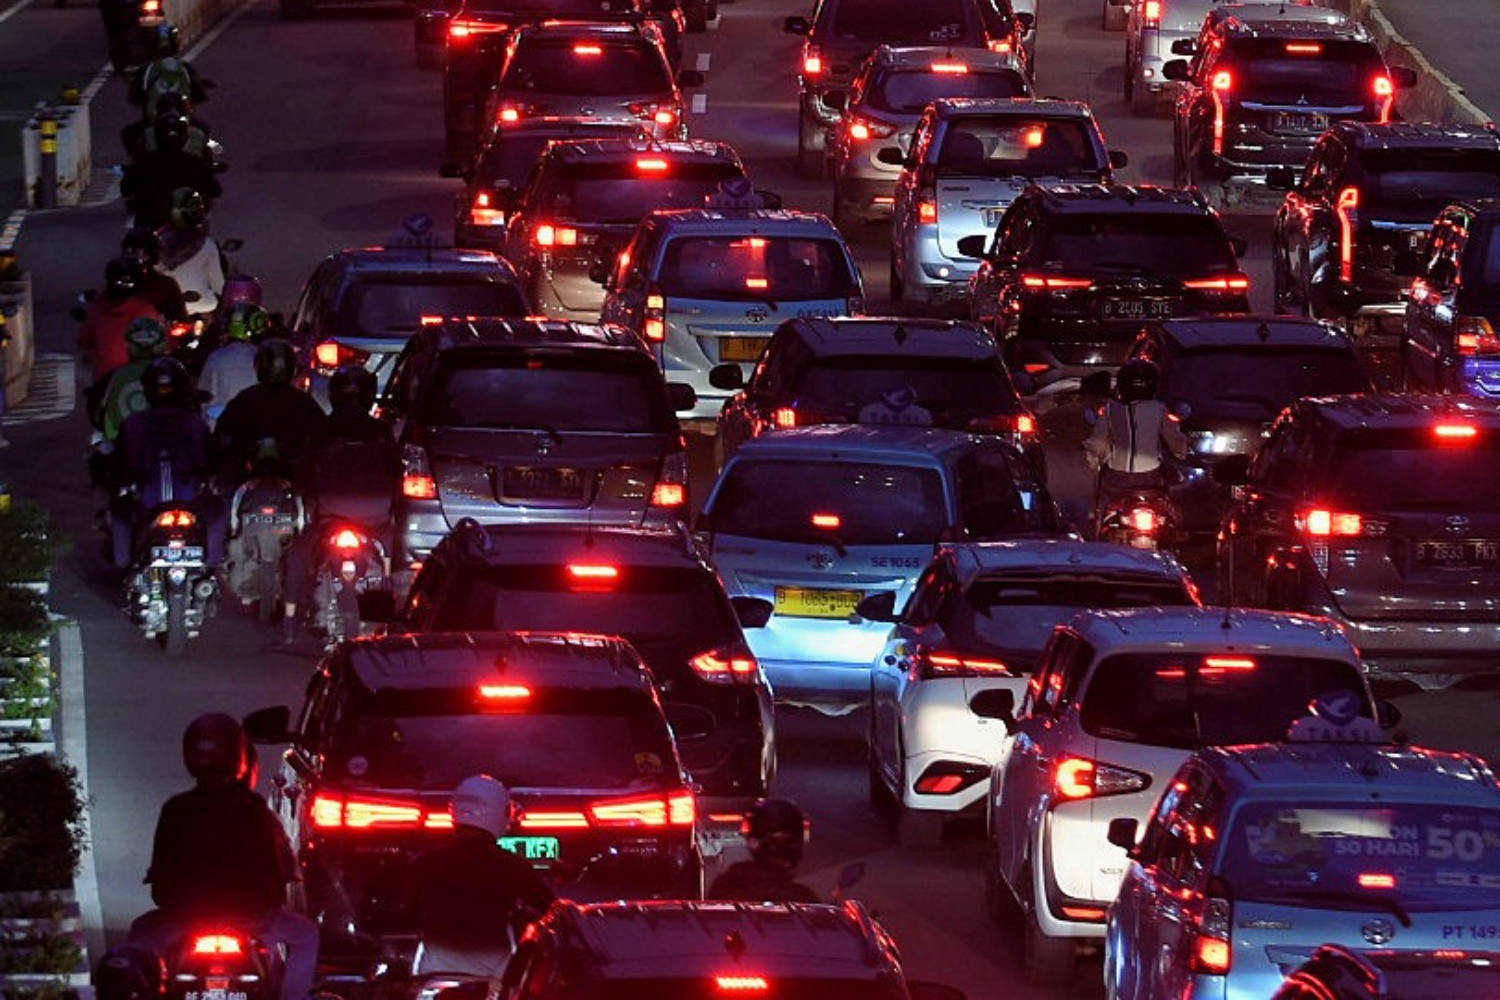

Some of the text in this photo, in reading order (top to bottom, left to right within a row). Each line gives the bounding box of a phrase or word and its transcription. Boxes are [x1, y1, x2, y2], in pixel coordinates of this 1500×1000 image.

[525, 840, 557, 859] KFX
[1334, 840, 1420, 857] 50 HARI
[1441, 925, 1463, 940] PT
